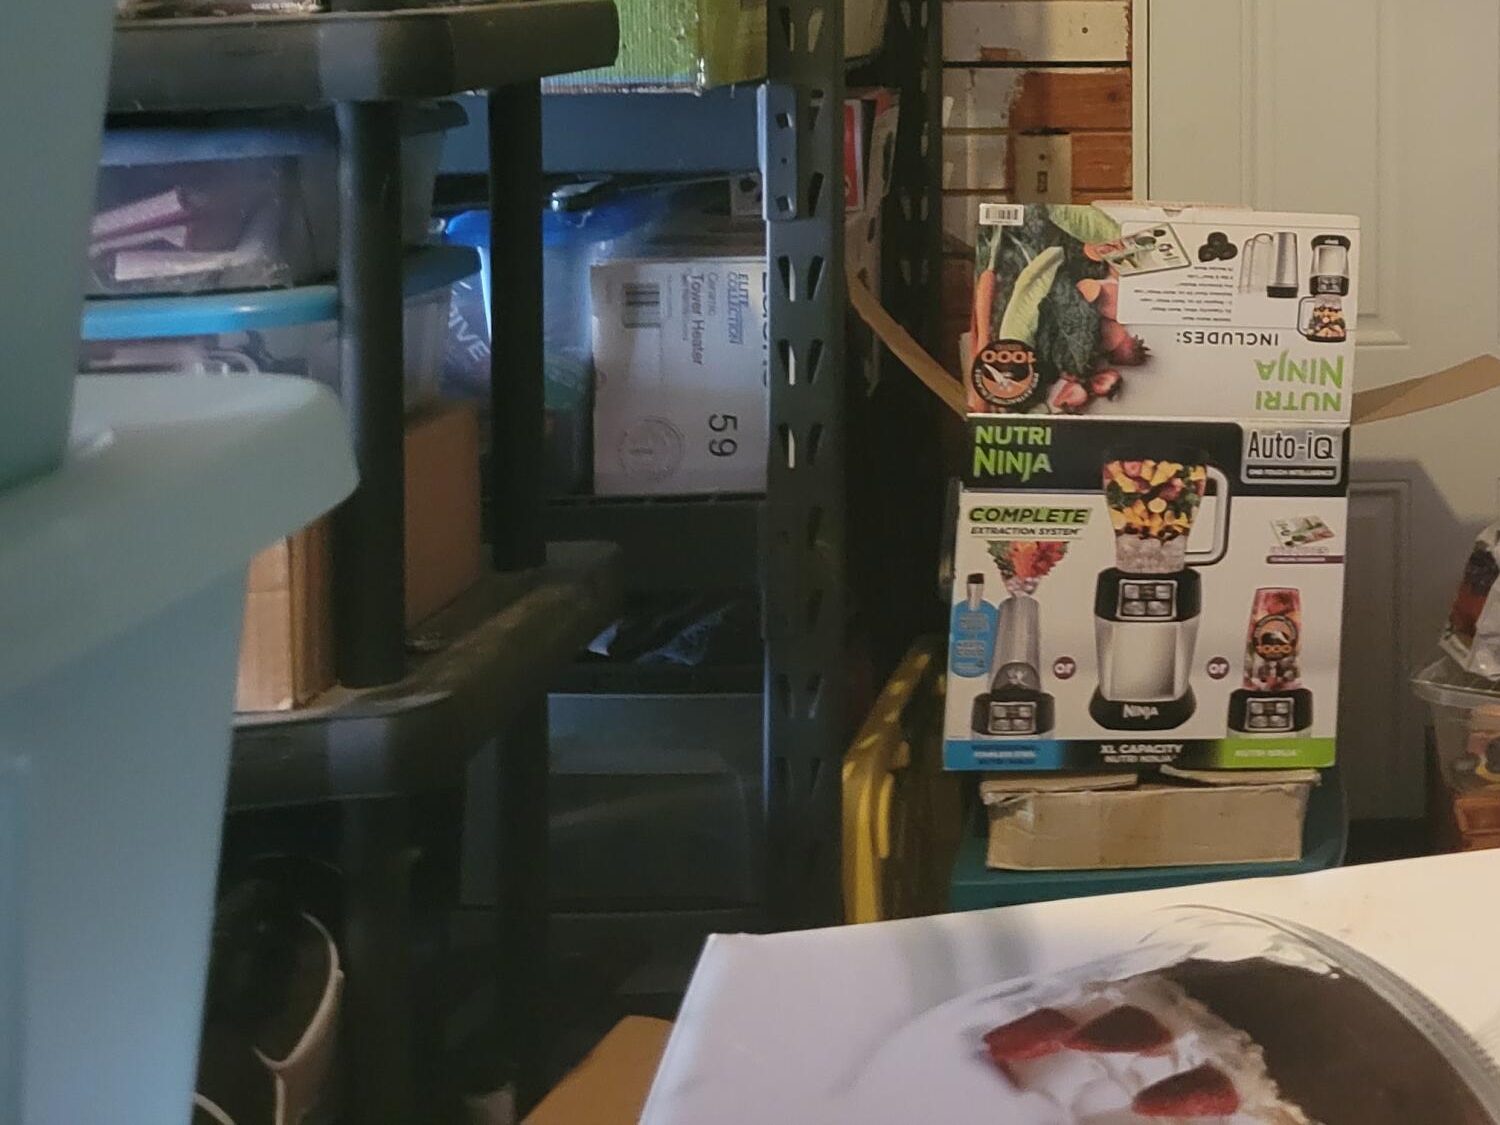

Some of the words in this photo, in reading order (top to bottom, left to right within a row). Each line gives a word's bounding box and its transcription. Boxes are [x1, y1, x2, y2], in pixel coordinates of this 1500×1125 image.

[690, 272, 704, 315] Tower
[738, 273, 749, 307] ELITE
[727, 271, 742, 345] COLLECTION
[692, 319, 705, 365] Heater
[1176, 330, 1279, 346] INCLUDES:
[981, 350, 1037, 364] 1000
[1254, 349, 1344, 389] NINJA
[1255, 390, 1342, 412] NUTRI
[975, 426, 1052, 445] NUTRI
[1248, 431, 1335, 460] Auto-iQ
[973, 446, 1053, 483] NINJA
[969, 507, 1088, 523] COMPLETE
[970, 526, 1035, 536] EXTRACTION
[1122, 704, 1159, 719] NINJA
[1100, 744, 1117, 754] XL
[1119, 744, 1184, 754] CAPACITY
